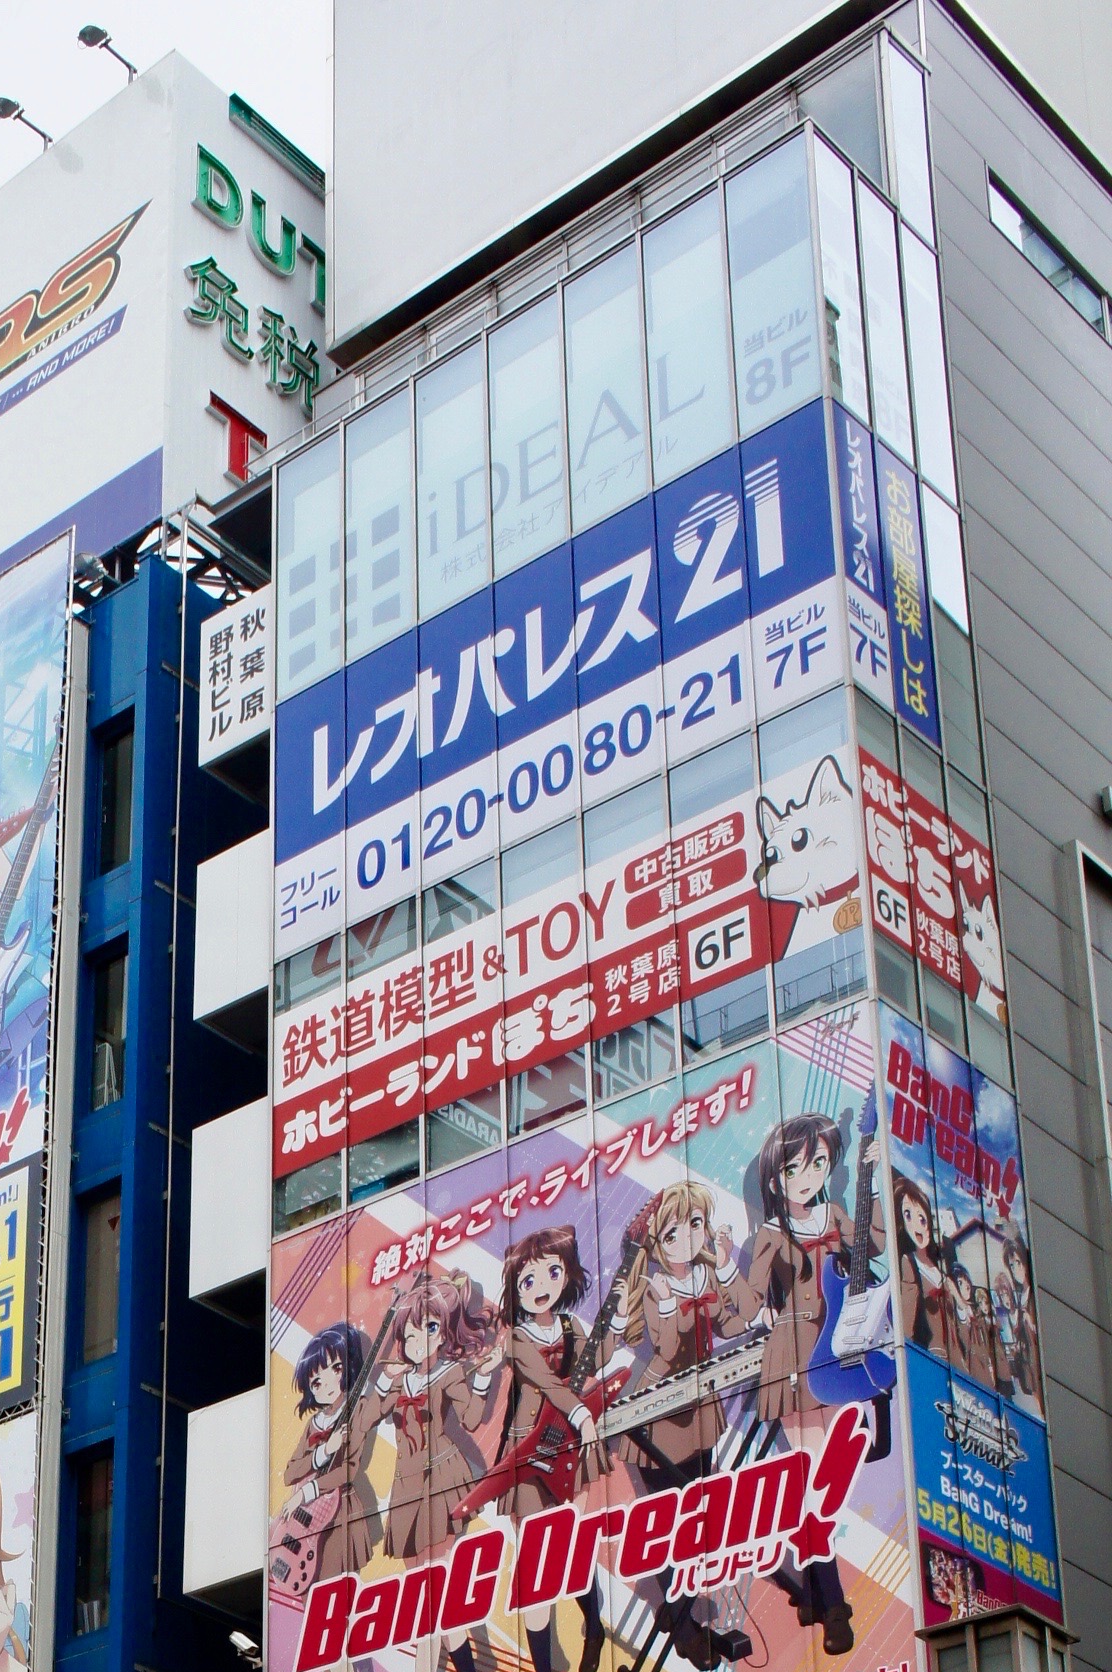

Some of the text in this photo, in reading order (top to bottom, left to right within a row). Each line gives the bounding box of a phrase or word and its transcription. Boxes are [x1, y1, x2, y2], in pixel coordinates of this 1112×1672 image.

[26, 304, 96, 361] ANIBRO
[26, 362, 57, 391] AND
[62, 316, 116, 366] MORE!
[185, 254, 320, 417] 免税
[744, 307, 809, 358] 当ビル
[745, 334, 813, 406] 8F
[427, 360, 709, 558] iDEAL
[441, 432, 679, 584] 株式会社アイデアル
[844, 419, 876, 595] レオパレス21
[764, 601, 826, 646] 当ビル
[846, 594, 886, 640] 当ビル
[884, 468, 929, 719] お部屋探しは
[238, 611, 266, 726] 秋葉原
[313, 458, 786, 815] レオパレス21
[765, 624, 828, 690] 7F
[848, 622, 889, 680] 7F
[207, 628, 233, 745] 野村ビル
[633, 818, 736, 885] 中古販売
[862, 760, 990, 885] ホビーランド
[280, 867, 338, 906] フリー
[657, 864, 715, 915] 買取
[871, 804, 955, 921] ぽち
[280, 887, 341, 930] コール
[876, 886, 909, 937] 6F
[915, 906, 962, 956] 秋葉原
[604, 939, 681, 991] 秋葉原
[693, 915, 746, 971] 6F
[917, 936, 963, 982] 2号店
[605, 966, 682, 1019] 2号店
[887, 1038, 974, 1137] BanG
[939, 1449, 1029, 1513] ブースターパック
[939, 1474, 1034, 1544] BanG Dream!
[670, 1538, 785, 1600] バンドリ
[916, 1486, 1057, 1590] 5月26日(金)発売!
